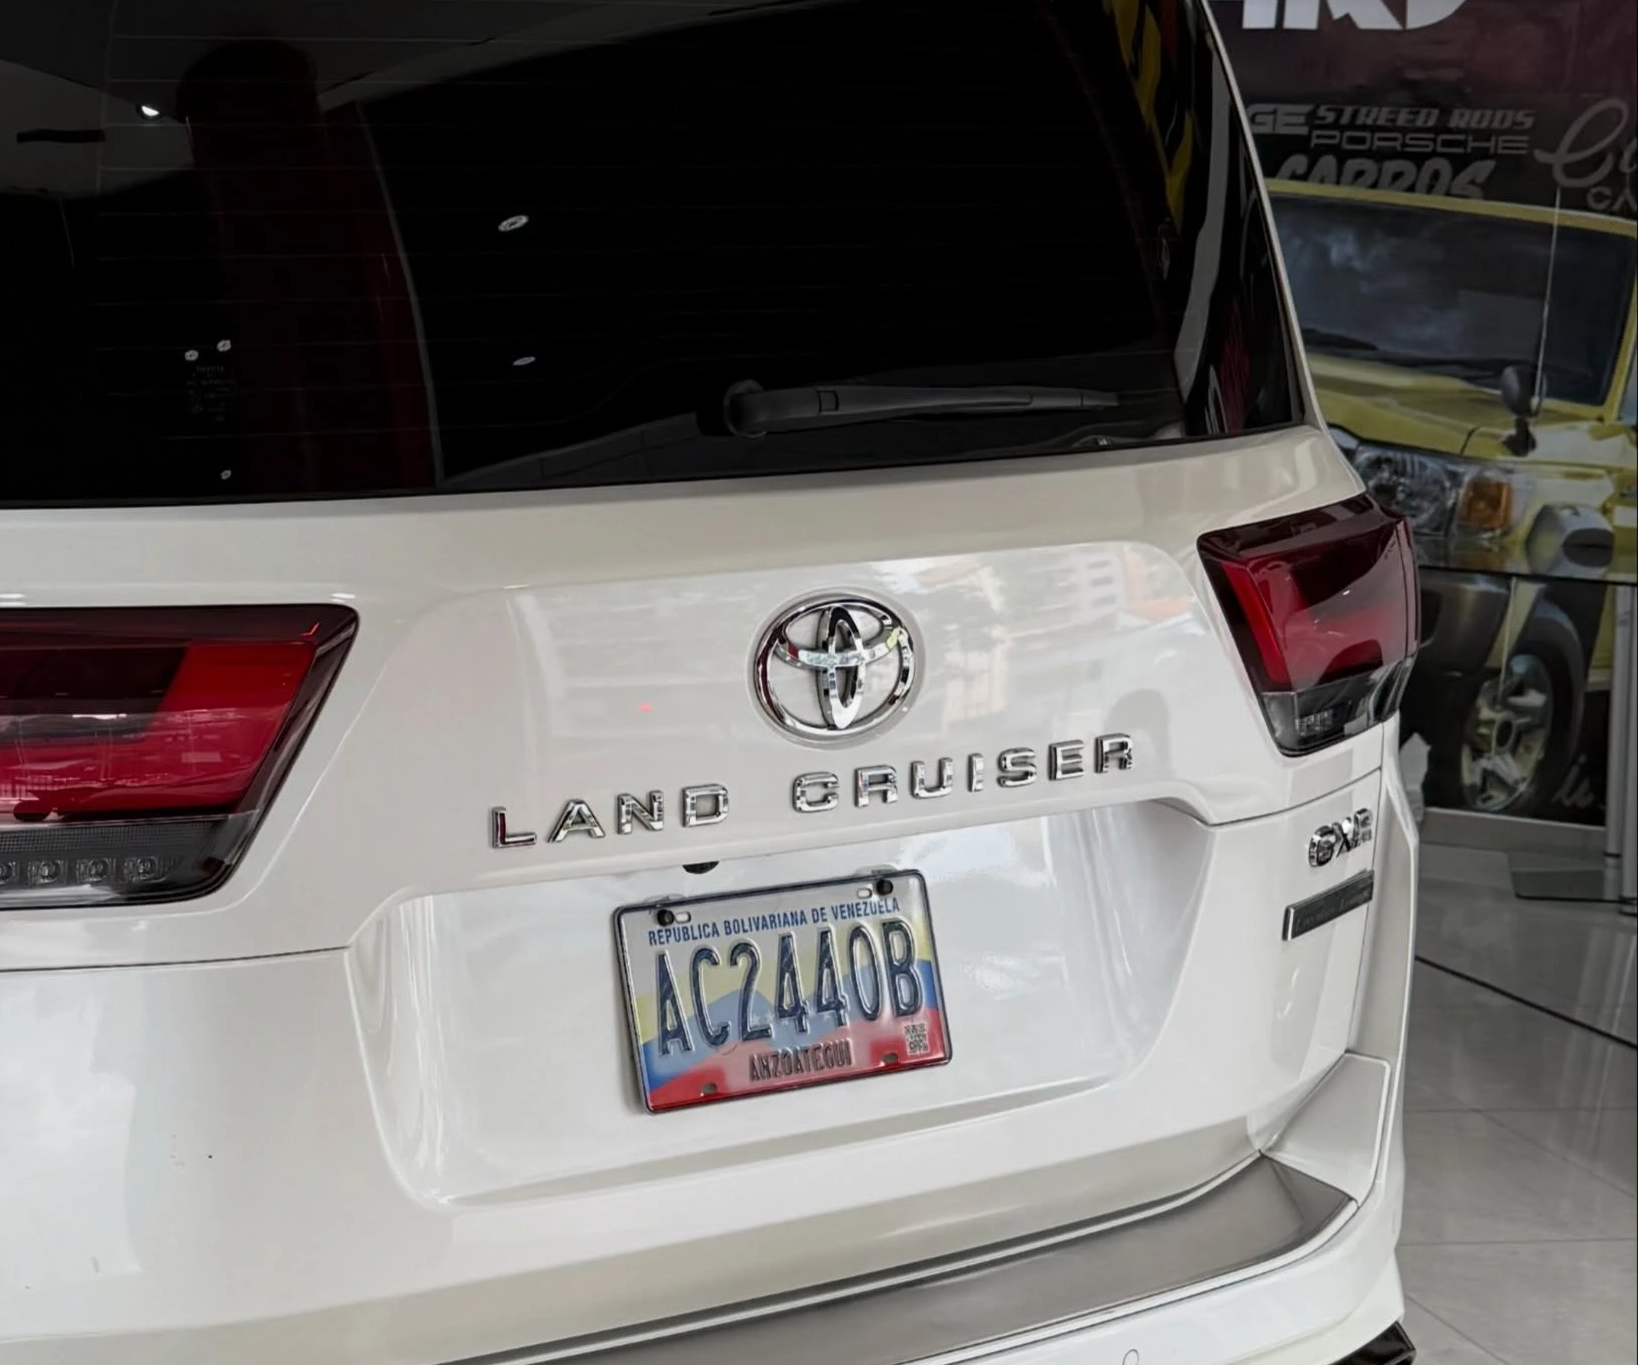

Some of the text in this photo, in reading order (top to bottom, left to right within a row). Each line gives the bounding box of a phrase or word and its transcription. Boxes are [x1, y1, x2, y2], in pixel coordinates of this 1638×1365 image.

[1311, 130, 1530, 154] PORSCHE
[492, 733, 1134, 848] LAND CRUISER
[648, 897, 901, 947] REPUBLICA BOLIVARIANA DE VENEZUELA
